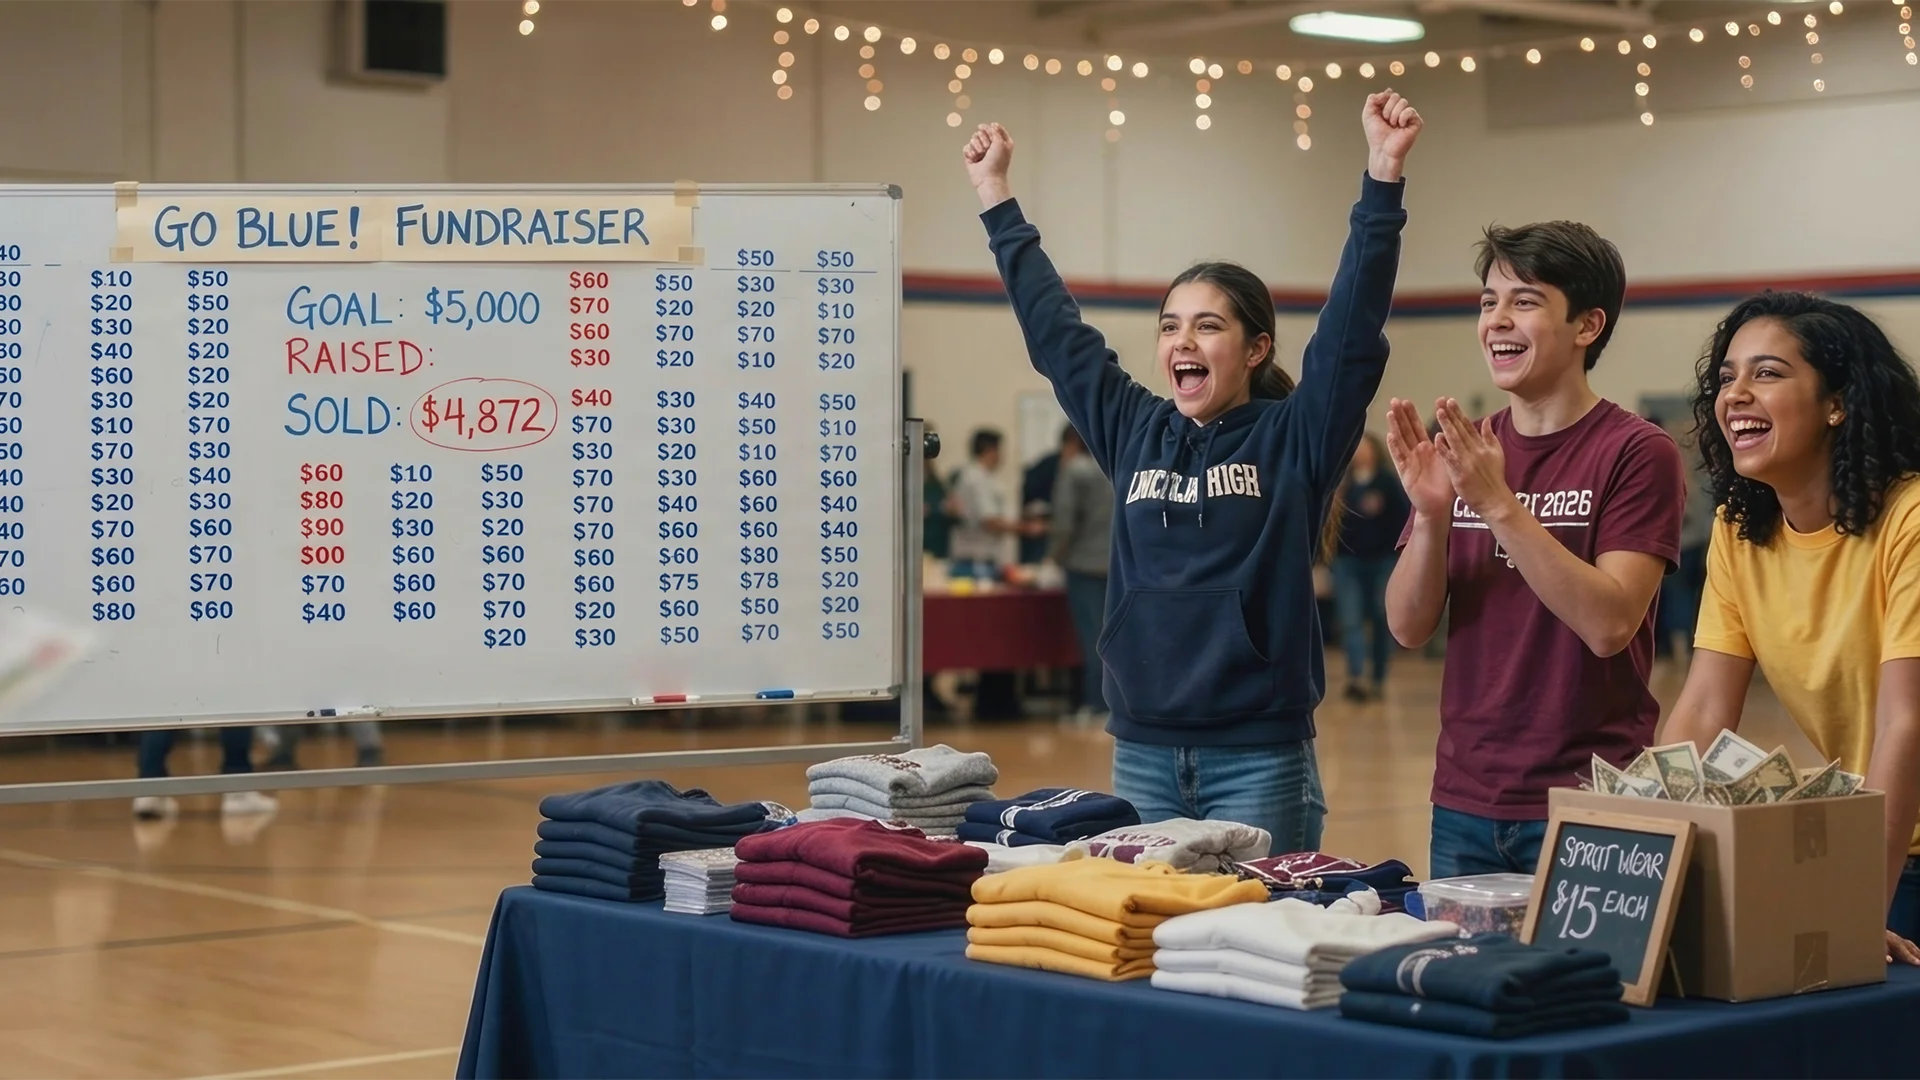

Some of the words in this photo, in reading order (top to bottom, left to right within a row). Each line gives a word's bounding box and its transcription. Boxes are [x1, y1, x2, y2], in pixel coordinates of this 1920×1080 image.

[154, 205, 217, 251] GO
[236, 206, 361, 250] BLUE!
[397, 203, 650, 246] FUNDRAISER
[0, 245, 21, 261] 40
[737, 249, 774, 267] $50
[817, 250, 854, 268] $50
[90, 269, 133, 289] $10
[187, 269, 229, 289] $50
[569, 270, 609, 290] $60
[655, 274, 693, 292] $50
[737, 275, 775, 293] $30
[817, 277, 854, 295] $30
[90, 293, 133, 313] $20
[187, 293, 229, 313] $50
[286, 285, 404, 330] GOAL:
[424, 286, 540, 331] $5,000
[569, 296, 610, 315] $70
[655, 298, 693, 317] $20
[737, 300, 775, 318] $20
[818, 302, 854, 320] $10
[90, 317, 133, 336] $30
[187, 317, 229, 336] $20
[569, 322, 610, 341] $60
[656, 324, 694, 342] $70
[738, 326, 775, 344] $70
[818, 327, 855, 344] $70
[90, 341, 133, 361] $40
[188, 341, 230, 361] $20
[285, 337, 434, 376] RAISED:
[570, 348, 611, 368] $30
[656, 349, 694, 368] $20
[737, 351, 775, 370] $10
[819, 352, 855, 370] $20
[90, 366, 133, 387] $60
[188, 366, 230, 386] $20
[0, 392, 22, 409] 70
[90, 391, 133, 411] $30
[188, 391, 230, 410] $20
[571, 388, 612, 407] $40
[657, 390, 695, 409] $30
[738, 391, 776, 409] $40
[819, 393, 856, 411] $50
[188, 415, 231, 435] $70
[284, 392, 401, 436] SOLD:
[421, 394, 546, 440] $4,872
[571, 415, 613, 434] $70
[657, 416, 696, 435] $30
[0, 417, 23, 435] 60
[91, 416, 133, 436] $10
[738, 417, 776, 436] $50
[820, 420, 856, 437] $10
[0, 443, 23, 461] 50
[91, 441, 133, 461] $70
[189, 441, 231, 461] $30
[572, 442, 613, 461] $30
[657, 442, 696, 461] $20
[739, 443, 777, 462] $10
[820, 444, 857, 463] $70
[0, 469, 23, 487] 40
[91, 467, 134, 487] $30
[189, 466, 231, 486] $40
[300, 462, 343, 485] $60
[390, 463, 433, 484] $10
[481, 463, 524, 483] $50
[572, 469, 613, 488] $70
[657, 469, 697, 488] $30
[739, 469, 777, 488] $60
[820, 469, 857, 489] $60
[0, 496, 24, 513] 40
[91, 493, 134, 513] $20
[189, 492, 231, 511] $30
[300, 490, 344, 511] $80
[391, 490, 433, 511] $20
[481, 490, 524, 511] $30
[573, 495, 614, 515] $70
[658, 495, 698, 513] $40
[739, 495, 777, 514] $60
[820, 495, 857, 513] $40
[0, 523, 24, 540] 40
[91, 519, 135, 540] $70
[189, 518, 232, 538] $60
[300, 517, 345, 539] $90
[391, 517, 434, 539] $30
[482, 518, 524, 537] $20
[573, 522, 614, 542] $70
[658, 521, 698, 540] $60
[740, 521, 778, 539] $60
[820, 520, 858, 539] $40
[0, 550, 25, 568] 70
[91, 546, 135, 567] $60
[189, 544, 233, 565] $70
[300, 545, 345, 566] $00
[392, 544, 435, 566] $60
[482, 545, 525, 565] $60
[574, 548, 615, 568] $60
[659, 547, 699, 566] $60
[740, 546, 779, 565] $80
[821, 545, 858, 565] $50
[0, 578, 25, 596] 60
[92, 575, 135, 596] $60
[189, 573, 233, 593] $70
[301, 574, 345, 595] $70
[393, 573, 436, 594] $60
[482, 572, 525, 593] $70
[574, 575, 615, 594] $60
[659, 573, 699, 593] $75
[740, 571, 779, 590] $78
[822, 571, 858, 589] $20
[92, 602, 136, 622] $80
[190, 600, 233, 622] $60
[302, 602, 346, 624] $40
[393, 601, 436, 623] $60
[483, 600, 526, 621] $70
[575, 601, 615, 620] $20
[659, 599, 699, 618] $60
[741, 597, 779, 616] $50
[822, 596, 859, 614] $20
[483, 628, 526, 649] $20
[575, 628, 616, 649] $30
[660, 626, 699, 645] $50
[742, 624, 779, 642] $70
[823, 623, 859, 639] $50
[1602, 890, 1649, 922] EACH
